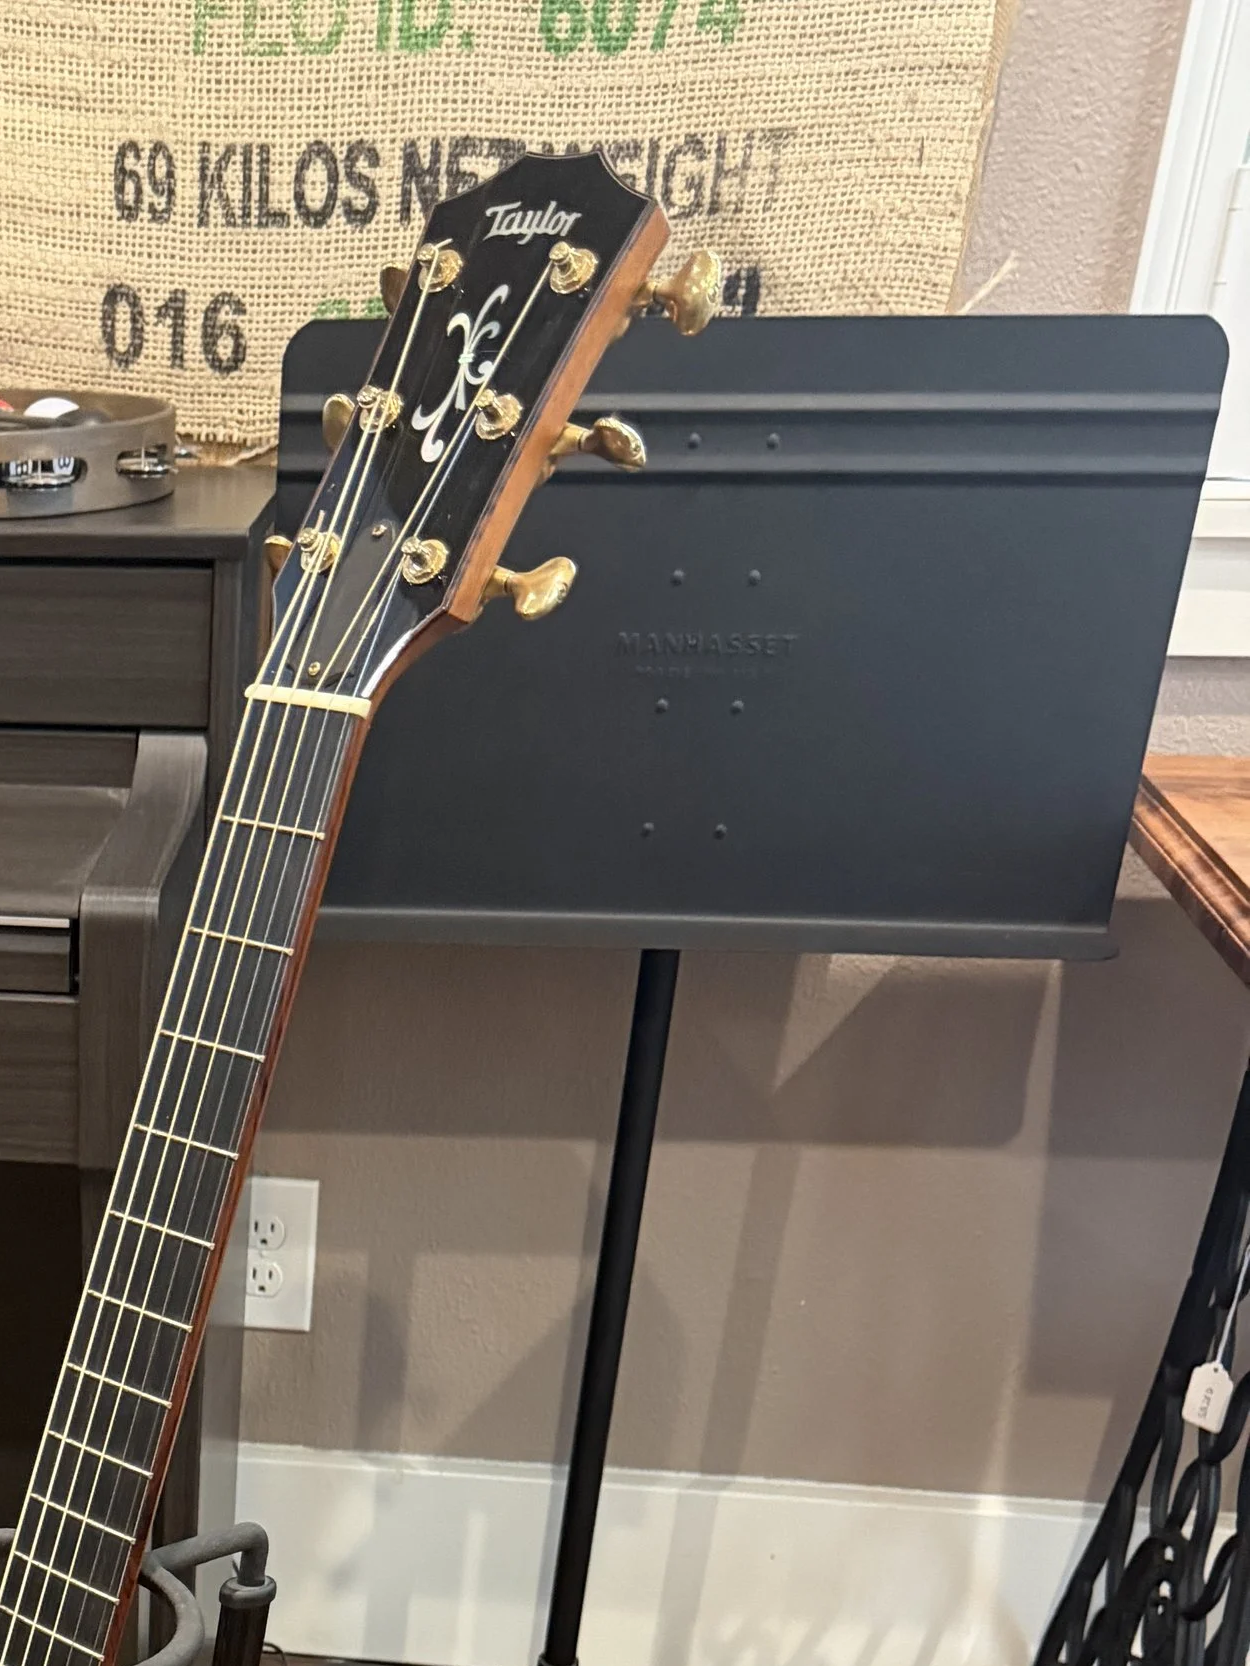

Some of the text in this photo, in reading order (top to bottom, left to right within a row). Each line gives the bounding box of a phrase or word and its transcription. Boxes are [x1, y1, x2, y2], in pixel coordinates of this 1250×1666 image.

[113, 140, 176, 225] 69
[197, 138, 382, 228] KILOS
[483, 200, 582, 245] Taylor
[101, 282, 248, 375] 016
